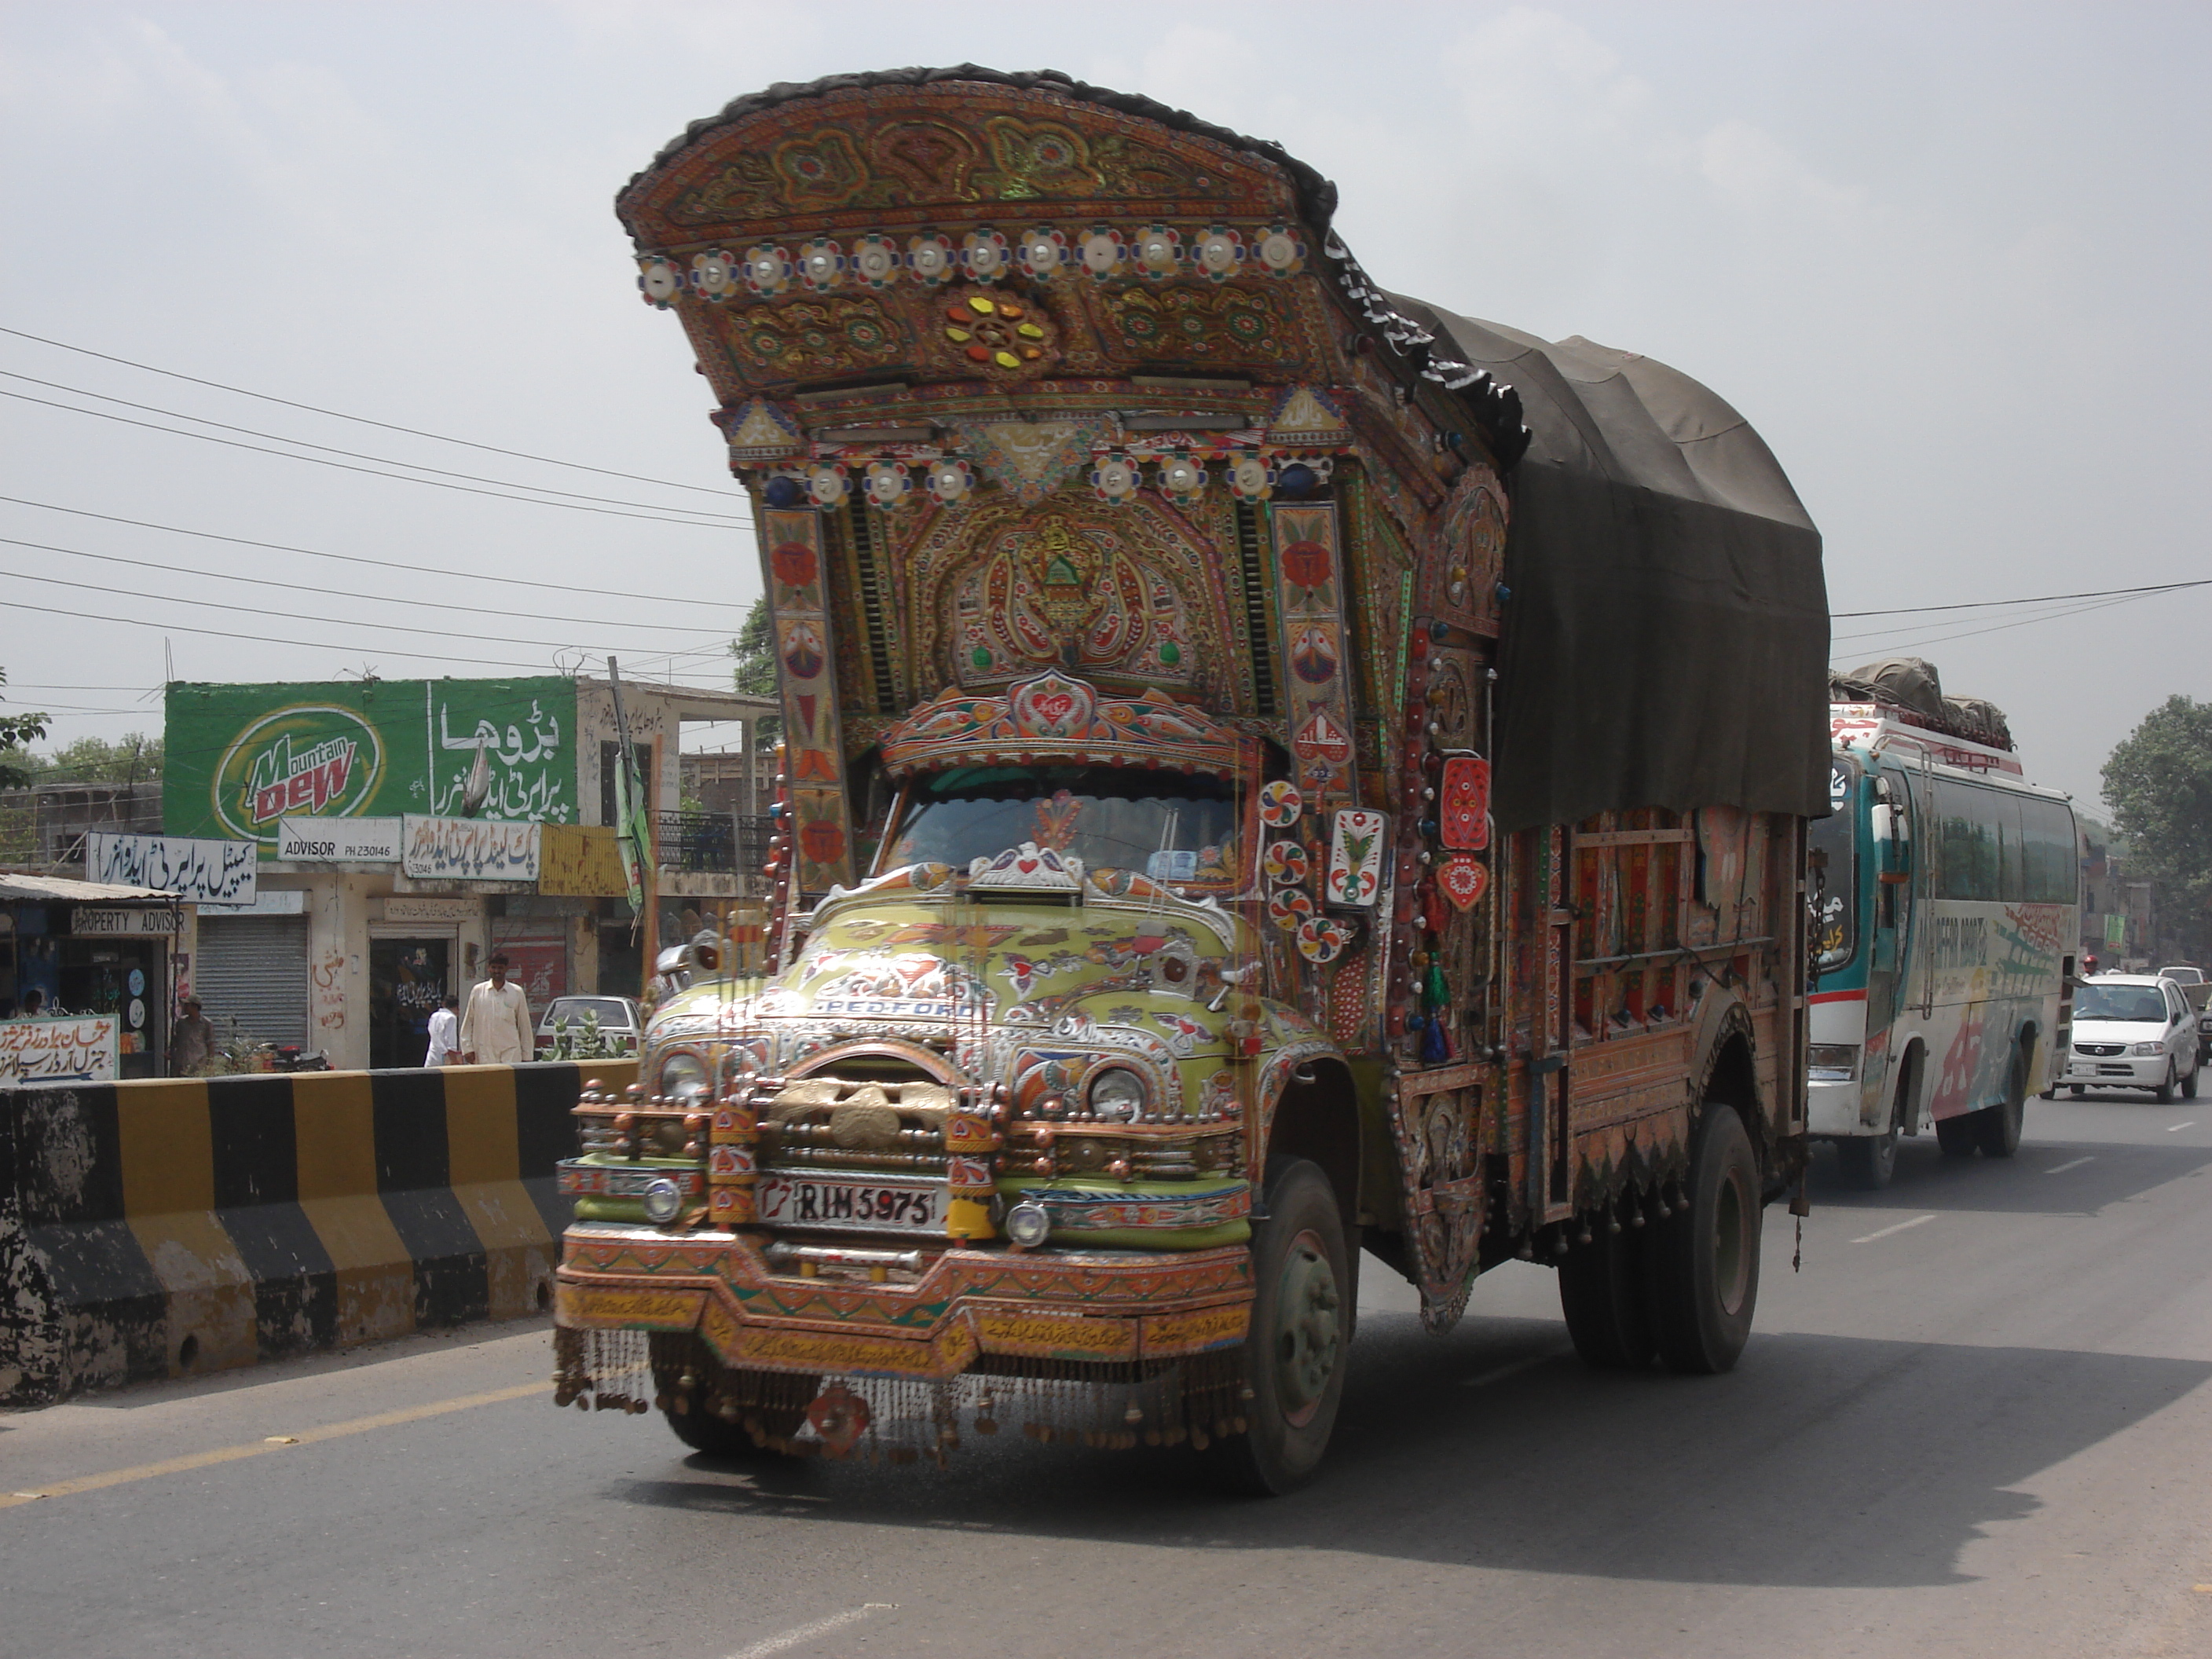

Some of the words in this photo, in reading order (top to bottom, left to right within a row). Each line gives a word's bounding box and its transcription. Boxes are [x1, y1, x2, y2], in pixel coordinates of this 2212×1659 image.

[246, 734, 350, 807] Mountain
[284, 841, 335, 855] ADVISOR
[357, 846, 390, 856] 230146
[141, 911, 185, 932] ADVISOR
[856, 1189, 929, 1224] 5975
